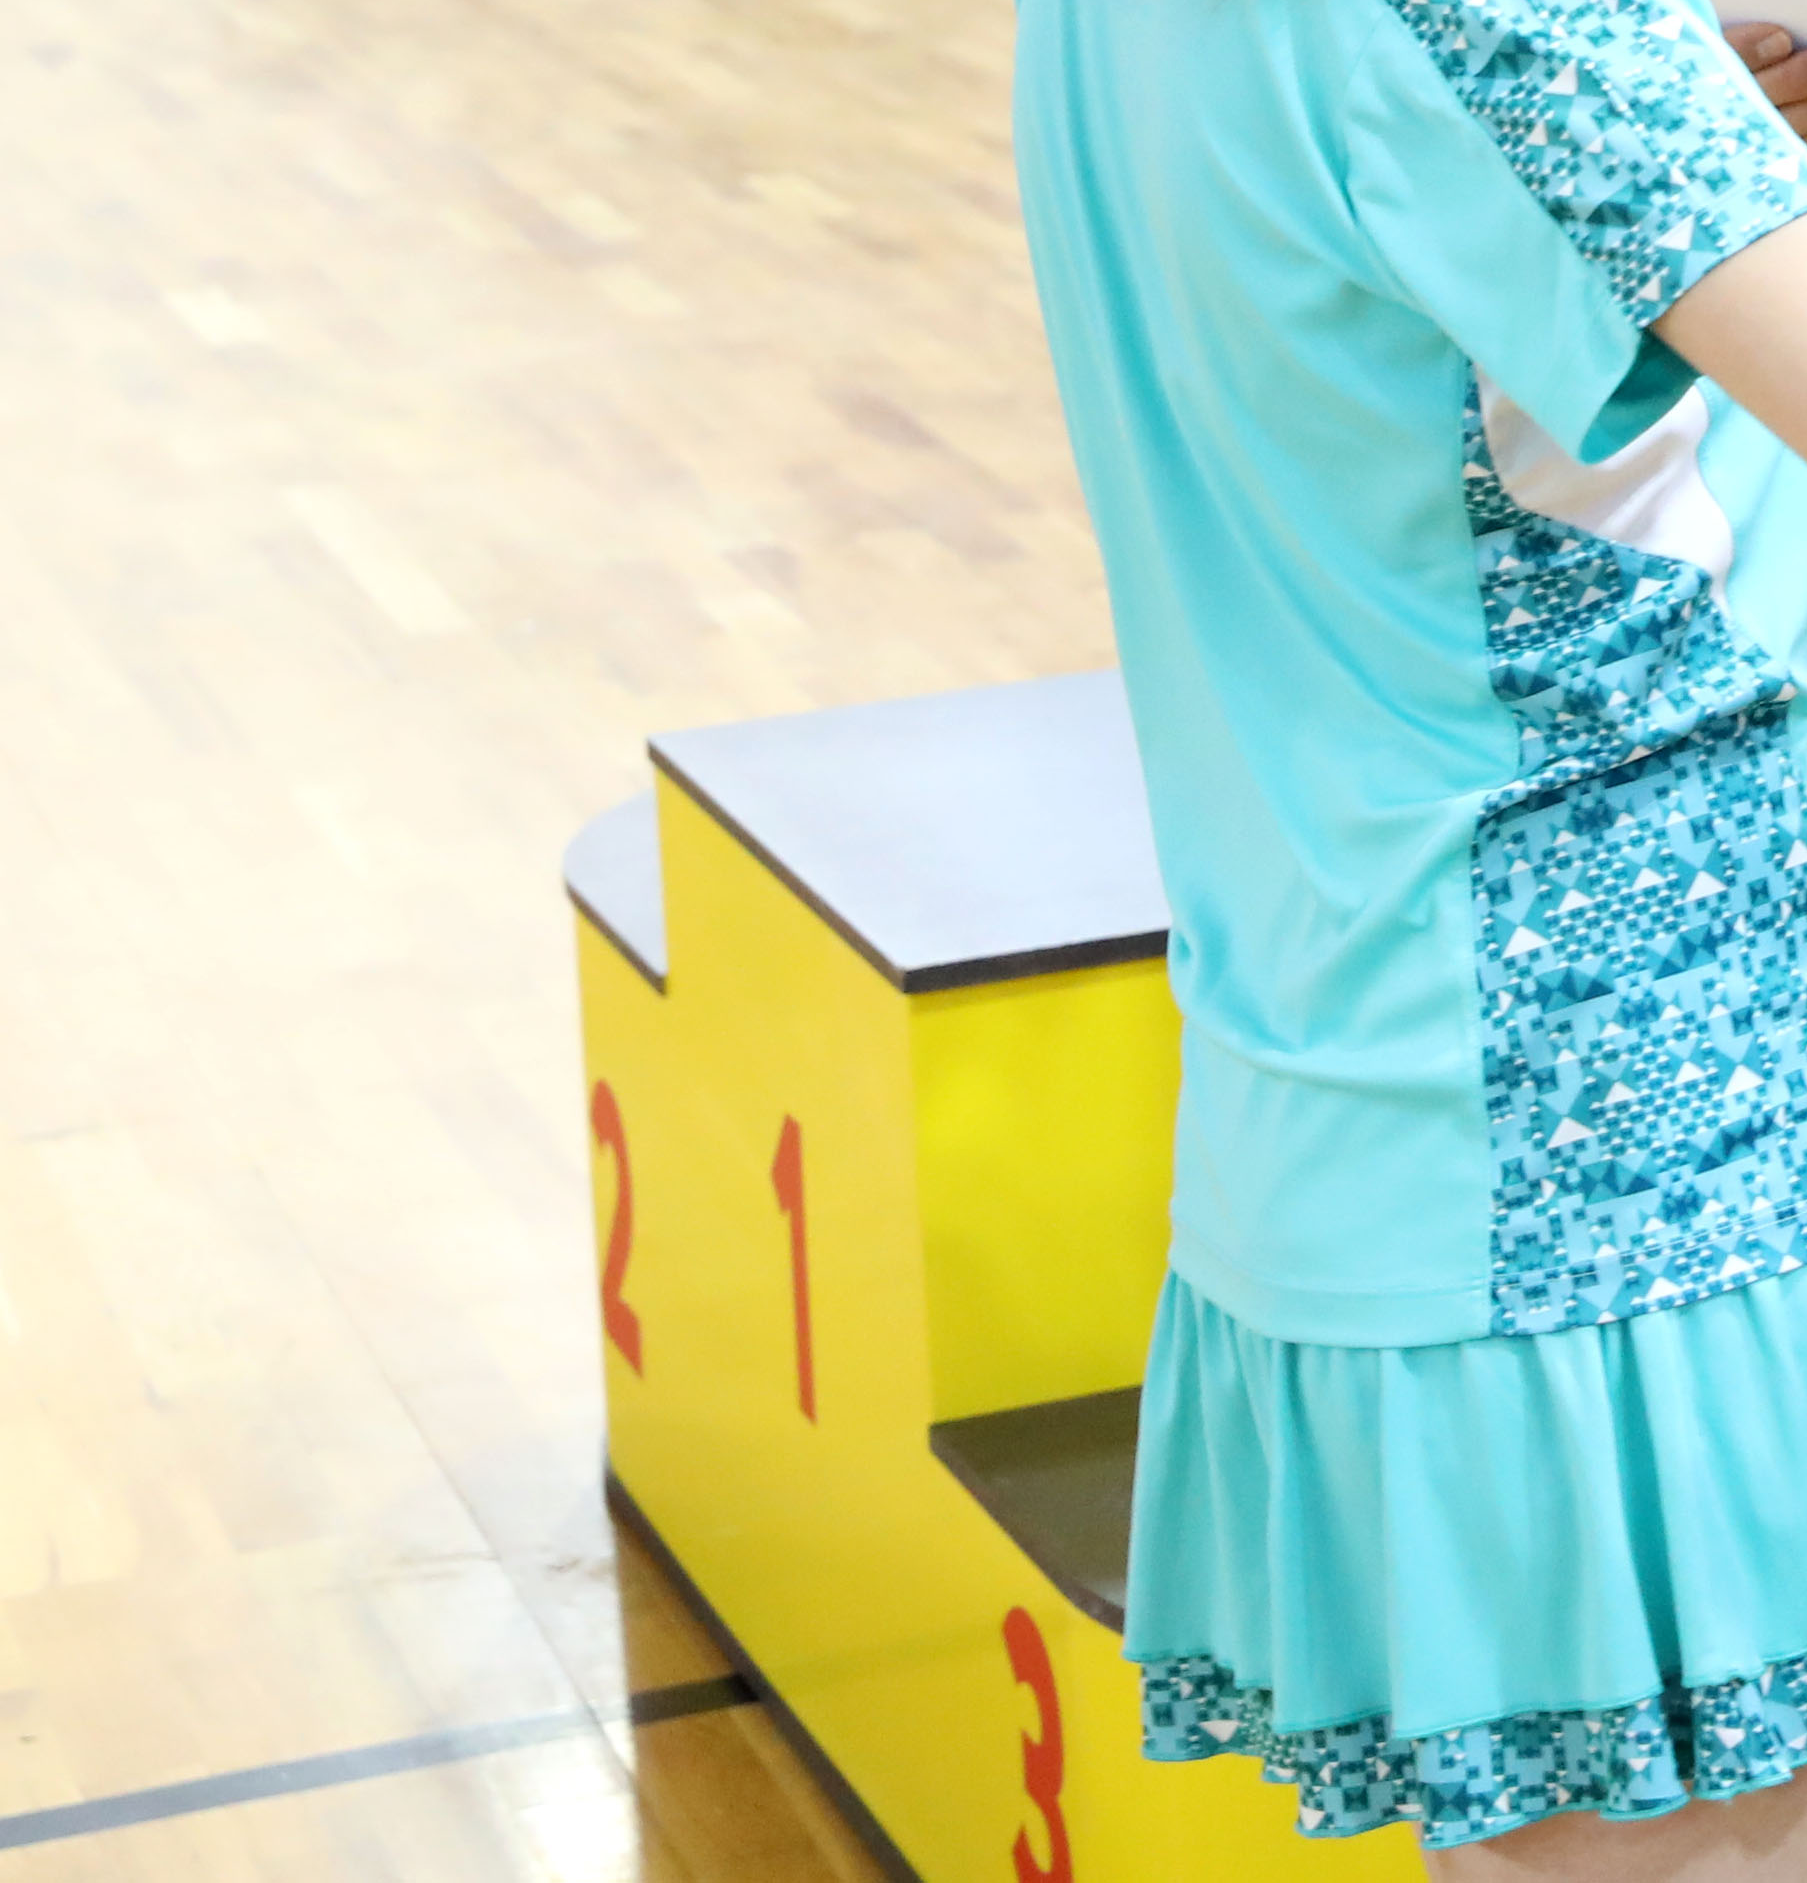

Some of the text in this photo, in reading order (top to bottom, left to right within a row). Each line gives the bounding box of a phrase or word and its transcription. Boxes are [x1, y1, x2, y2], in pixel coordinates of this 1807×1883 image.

[591, 1079, 643, 1380] 2
[772, 1113, 817, 1426] 1
[1003, 1606, 1074, 1883] 3
